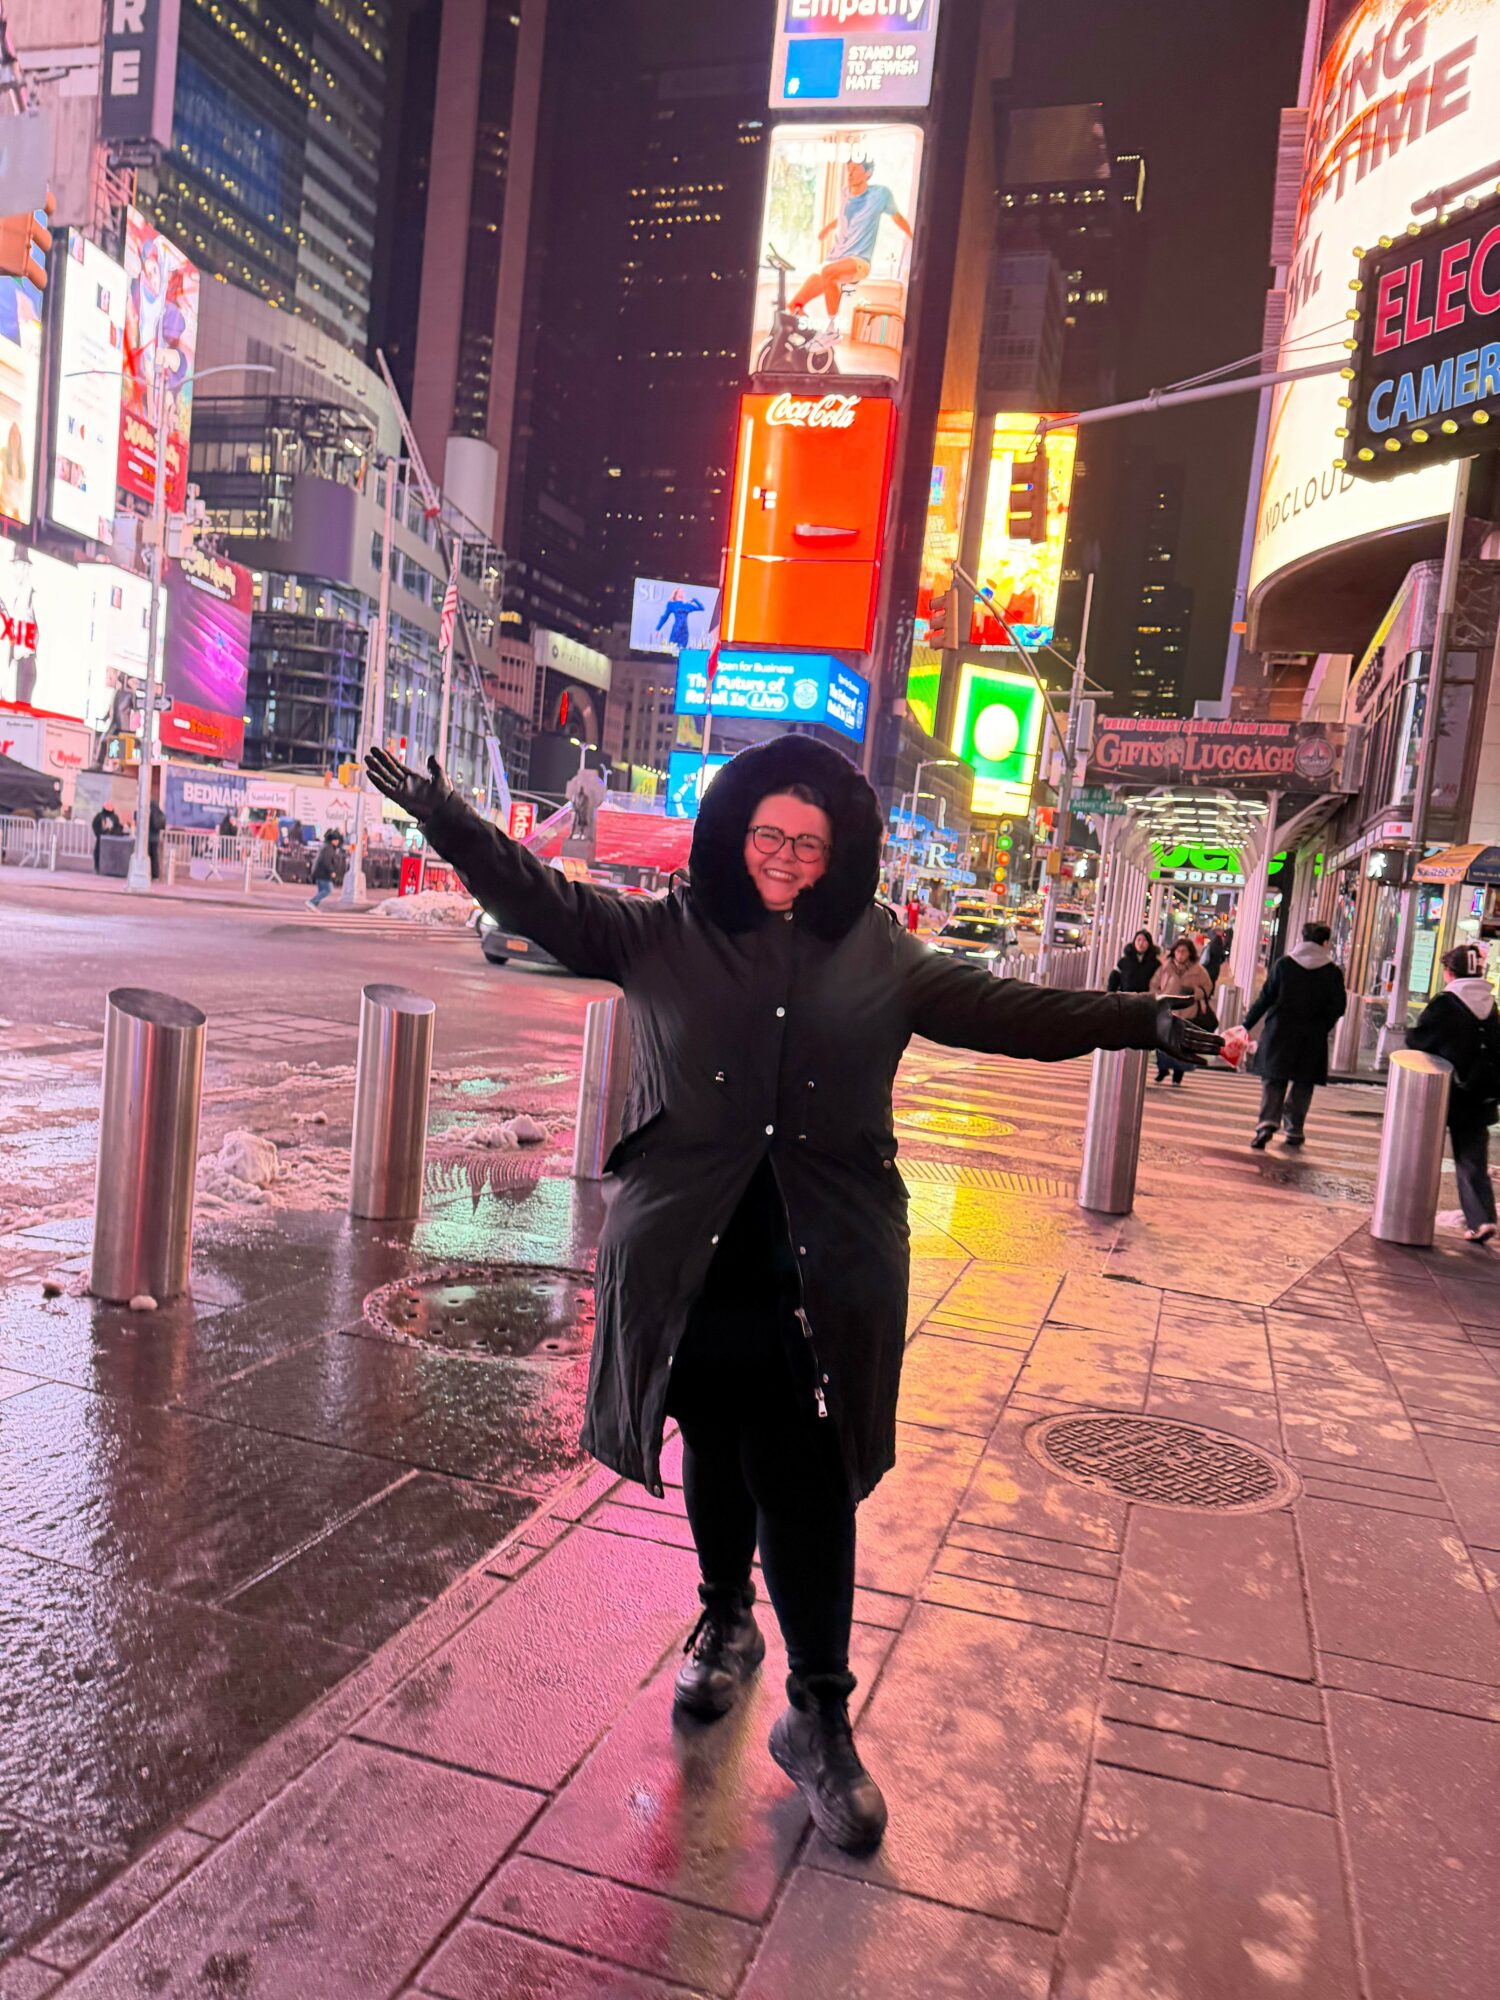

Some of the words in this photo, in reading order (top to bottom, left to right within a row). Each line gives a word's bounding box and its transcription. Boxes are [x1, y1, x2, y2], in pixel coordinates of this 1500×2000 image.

[848, 46, 893, 60] STAND
[896, 45, 916, 58] UP
[848, 61, 866, 75] TO
[868, 60, 919, 75] JEWISH
[846, 76, 882, 90] HATE
[1373, 224, 1500, 356] ELEC
[1367, 341, 1500, 433] CAMER
[739, 660, 752, 672] for
[753, 662, 795, 675] Business
[687, 673, 707, 688] Th
[716, 675, 766, 692] Future
[767, 677, 785, 692] of
[730, 692, 746, 706] Is
[752, 693, 784, 709] Live
[1104, 719, 1137, 731] VOTED
[1137, 719, 1183, 733] COOLEST
[1217, 721, 1232, 734] IN
[1232, 722, 1258, 735] NEW
[1259, 724, 1290, 736] YORK
[1183, 736, 1296, 772] LUGGAGE
[515, 806, 531, 838] tkts
